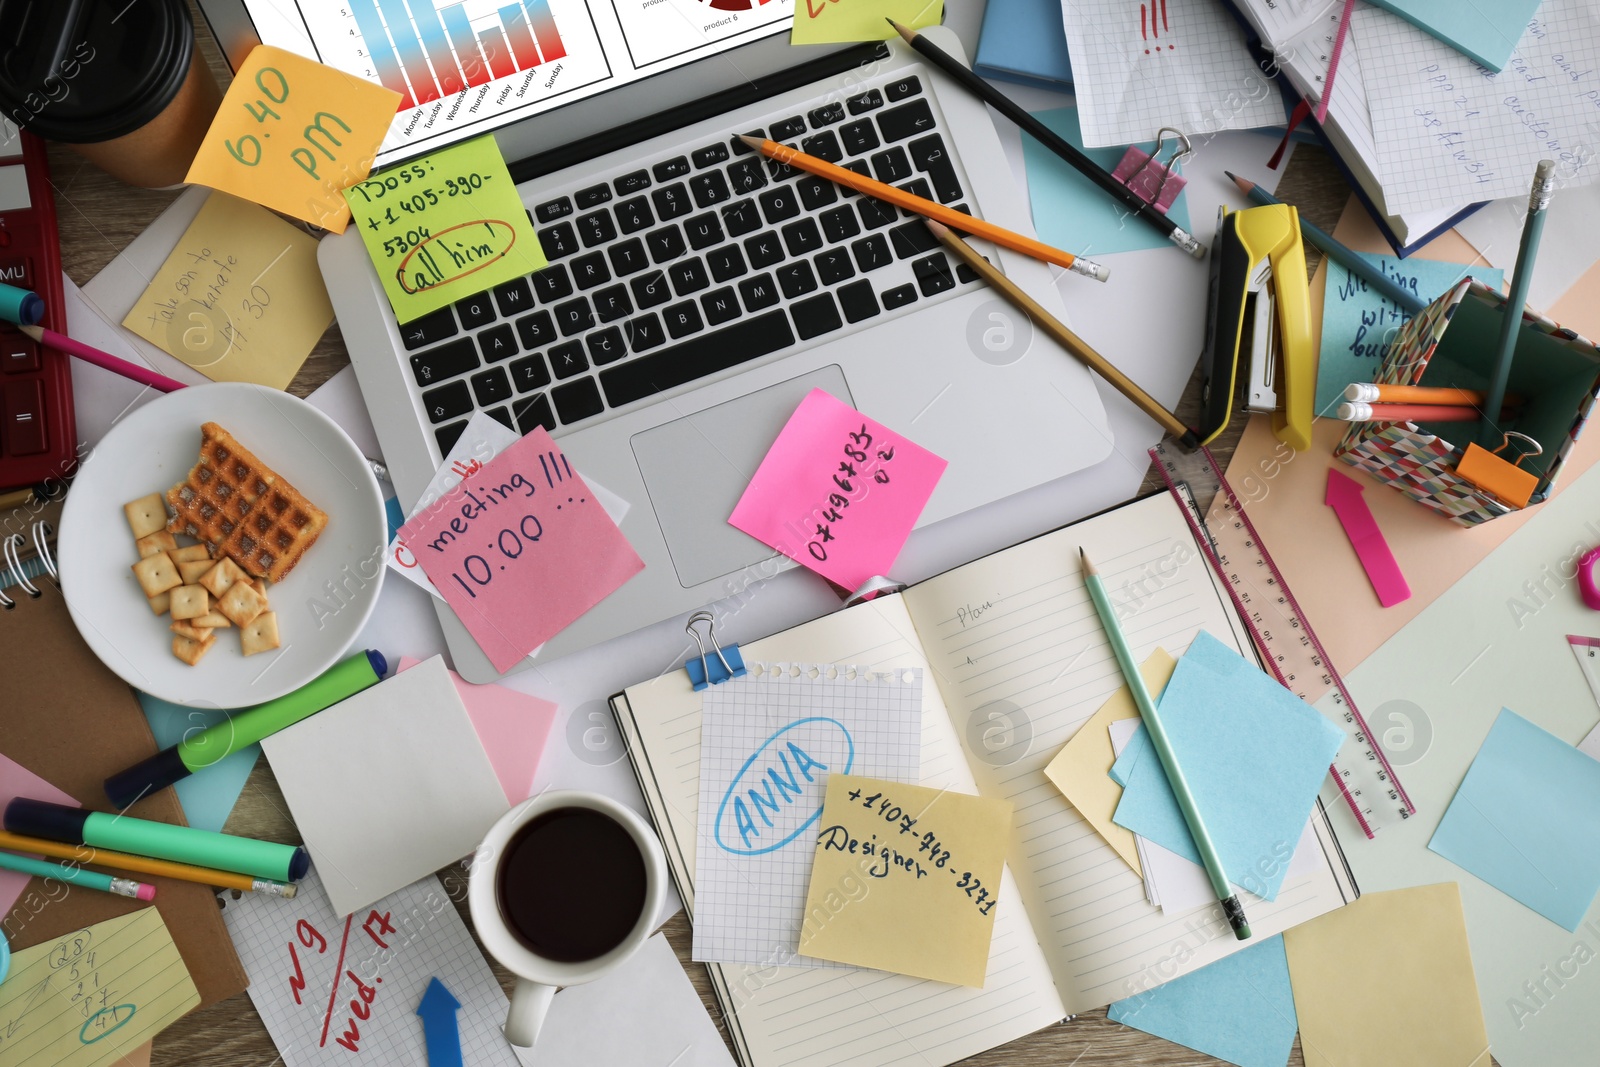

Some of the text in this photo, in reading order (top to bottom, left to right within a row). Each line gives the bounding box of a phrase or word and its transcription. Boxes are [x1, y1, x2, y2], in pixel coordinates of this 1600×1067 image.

[704, 13, 738, 32] product 6
[357, 49, 364, 57] 3
[365, 69, 372, 77] 2
[1552, 54, 1592, 82] and
[545, 63, 564, 90] Sunday
[516, 68, 536, 98] Saturday
[469, 84, 490, 114] Thursday
[497, 84, 512, 106] Friday
[446, 83, 470, 122] Wednesday
[225, 67, 290, 166] 6.40
[424, 102, 444, 130] Tuesday
[404, 108, 424, 136] Monday
[290, 111, 352, 182] pm
[351, 160, 436, 202] Boss:
[746, 176, 752, 185] 9
[708, 189, 716, 199] 8
[813, 186, 820, 196] P
[670, 202, 677, 212] 7
[774, 198, 784, 209] O
[633, 215, 640, 225] 6
[595, 229, 602, 238] 5
[699, 225, 709, 236] U
[384, 225, 430, 258] 5304
[798, 232, 806, 242] L
[557, 242, 564, 251] 4
[661, 238, 670, 248] Y
[760, 244, 769, 255] K
[187, 248, 212, 264] to
[623, 251, 632, 262] T
[723, 257, 730, 268] J
[397, 245, 444, 294] Call
[585, 265, 596, 276] R
[683, 271, 694, 281] H
[548, 278, 556, 289] E
[646, 283, 656, 295] G
[507, 291, 520, 302] W
[753, 287, 766, 298] M
[608, 297, 616, 308] F
[716, 300, 726, 311] N
[470, 305, 481, 316] Q
[570, 311, 579, 322] D
[679, 313, 688, 324] B
[532, 325, 540, 336] S
[640, 327, 648, 338] V
[494, 338, 504, 349] A
[602, 340, 611, 351] C
[563, 354, 573, 365] X
[525, 367, 534, 379] Z
[427, 473, 536, 552] meeting
[452, 515, 544, 598] 10:00
[1221, 555, 1230, 566] 14
[1231, 574, 1240, 584] 13
[1242, 592, 1252, 604] 12
[1253, 612, 1262, 623] 11
[1289, 617, 1299, 628] 10
[1263, 630, 1274, 641] 10
[1300, 636, 1310, 646] 11
[1311, 655, 1321, 666] 12
[1322, 674, 1332, 685] 13
[1332, 693, 1342, 704] 14
[1343, 712, 1354, 723] 15
[1354, 732, 1365, 743] 16
[1365, 750, 1376, 762] 17
[1376, 770, 1387, 782] 18
[733, 741, 828, 848] ANNA
[1388, 789, 1398, 800] 19
[1399, 808, 1409, 820] 20
